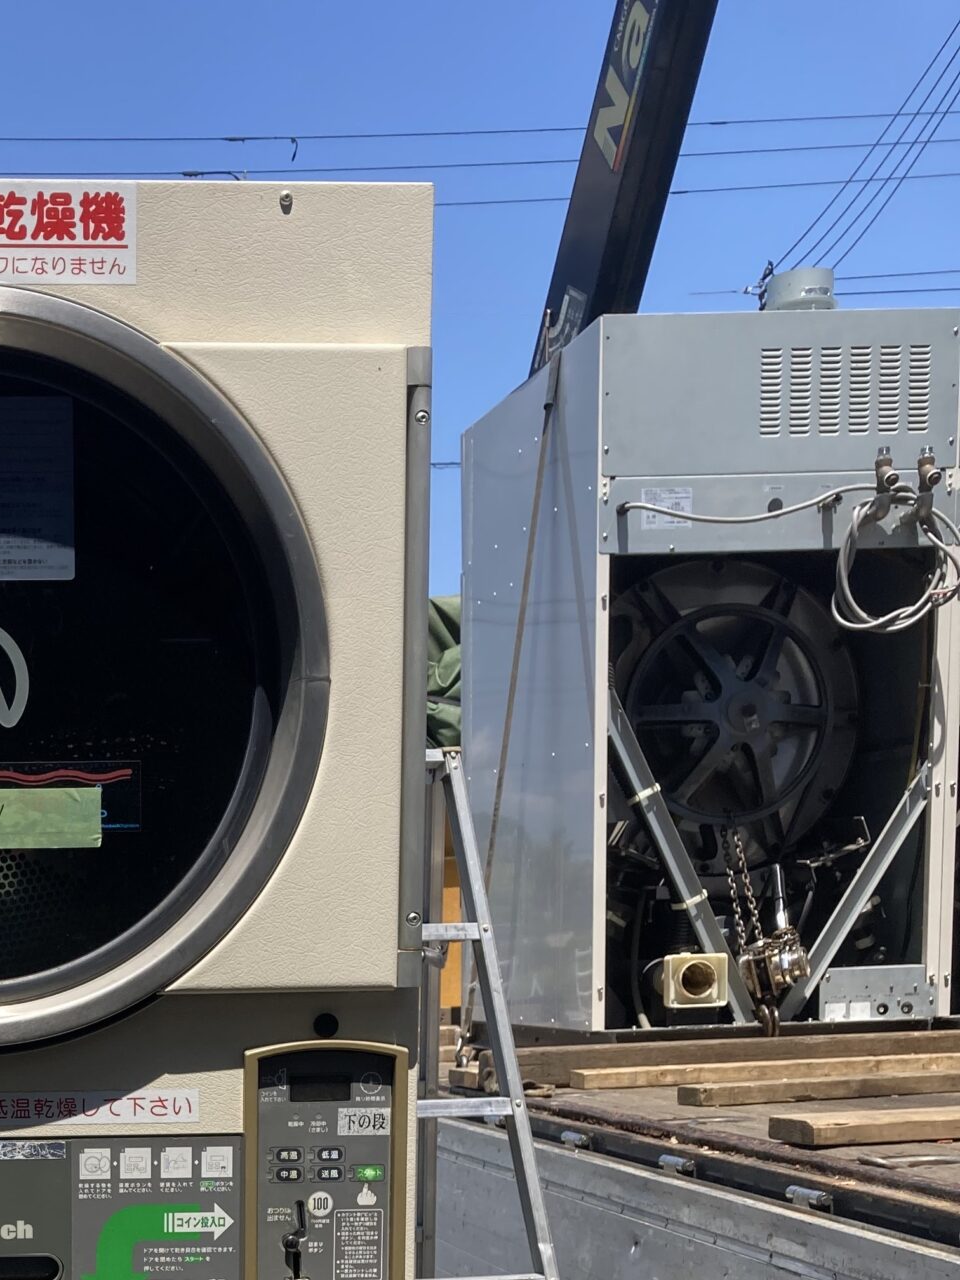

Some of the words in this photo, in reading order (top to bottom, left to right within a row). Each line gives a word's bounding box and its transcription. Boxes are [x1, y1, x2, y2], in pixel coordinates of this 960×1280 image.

[344, 1113, 386, 1131] 下の段
[312, 1196, 329, 1211] 100
[176, 1216, 226, 1228] コイン投入口
